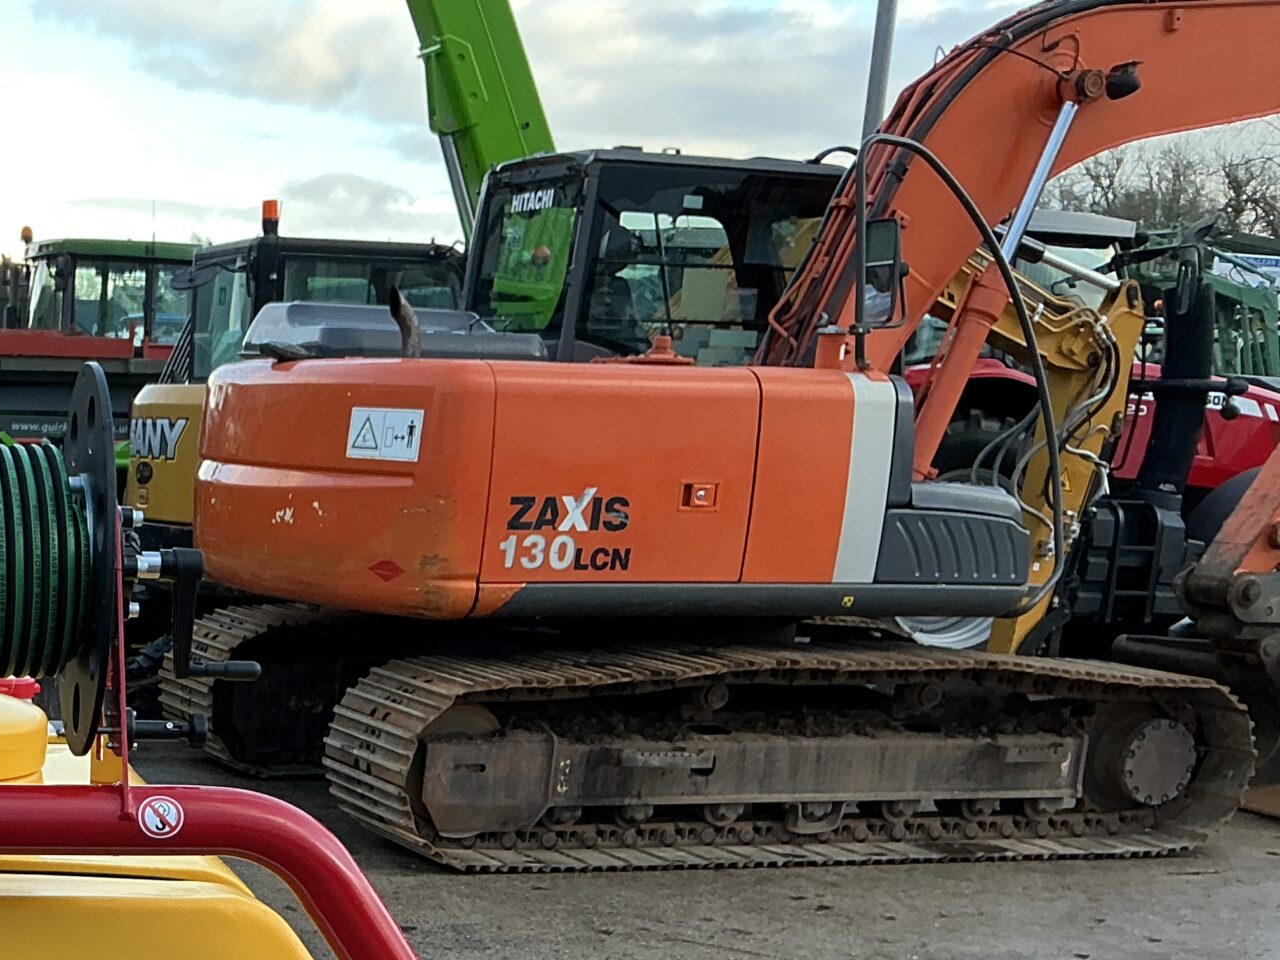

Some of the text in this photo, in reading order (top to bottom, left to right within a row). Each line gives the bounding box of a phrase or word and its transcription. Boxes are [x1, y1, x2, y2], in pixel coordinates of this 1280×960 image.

[511, 188, 555, 214] HITACHI
[507, 487, 630, 532] ZAXIS
[33, 553, 42, 589] POWER
